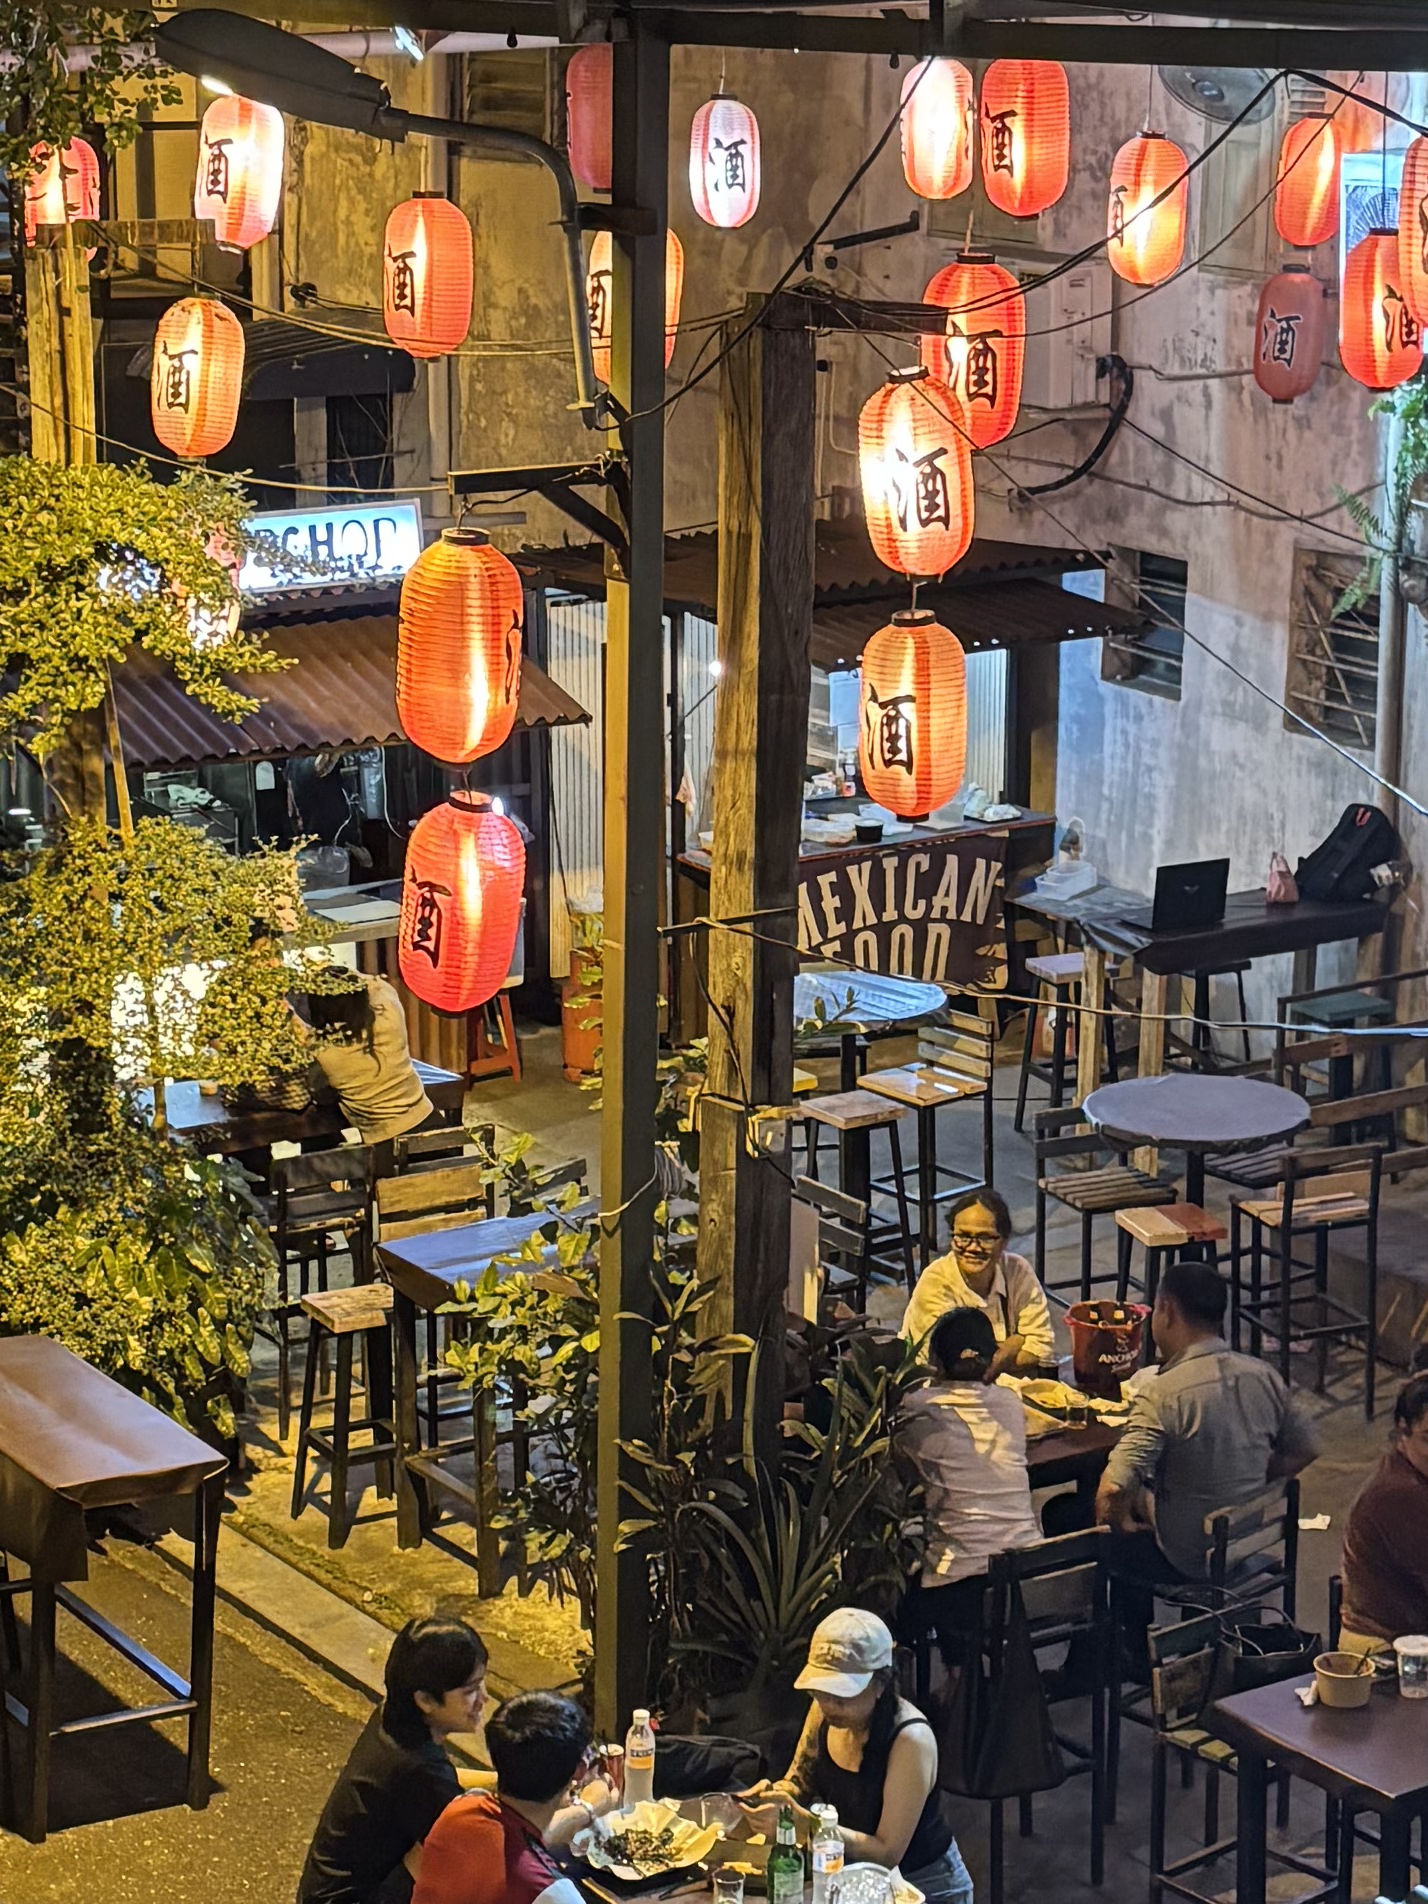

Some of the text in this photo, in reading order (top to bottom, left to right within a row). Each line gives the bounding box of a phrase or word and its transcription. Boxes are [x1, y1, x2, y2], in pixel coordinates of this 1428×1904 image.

[199, 131, 234, 204] 酒
[708, 137, 748, 192] 酒
[978, 102, 1018, 177] 酒
[385, 243, 417, 318] 酒
[1382, 283, 1419, 353] 酒
[947, 320, 1004, 409] 酒
[1263, 307, 1302, 369] 酒
[156, 340, 199, 415] 酒
[892, 446, 951, 533] 酒
[866, 682, 917, 776] 酒
[821, 923, 952, 982] OOD
